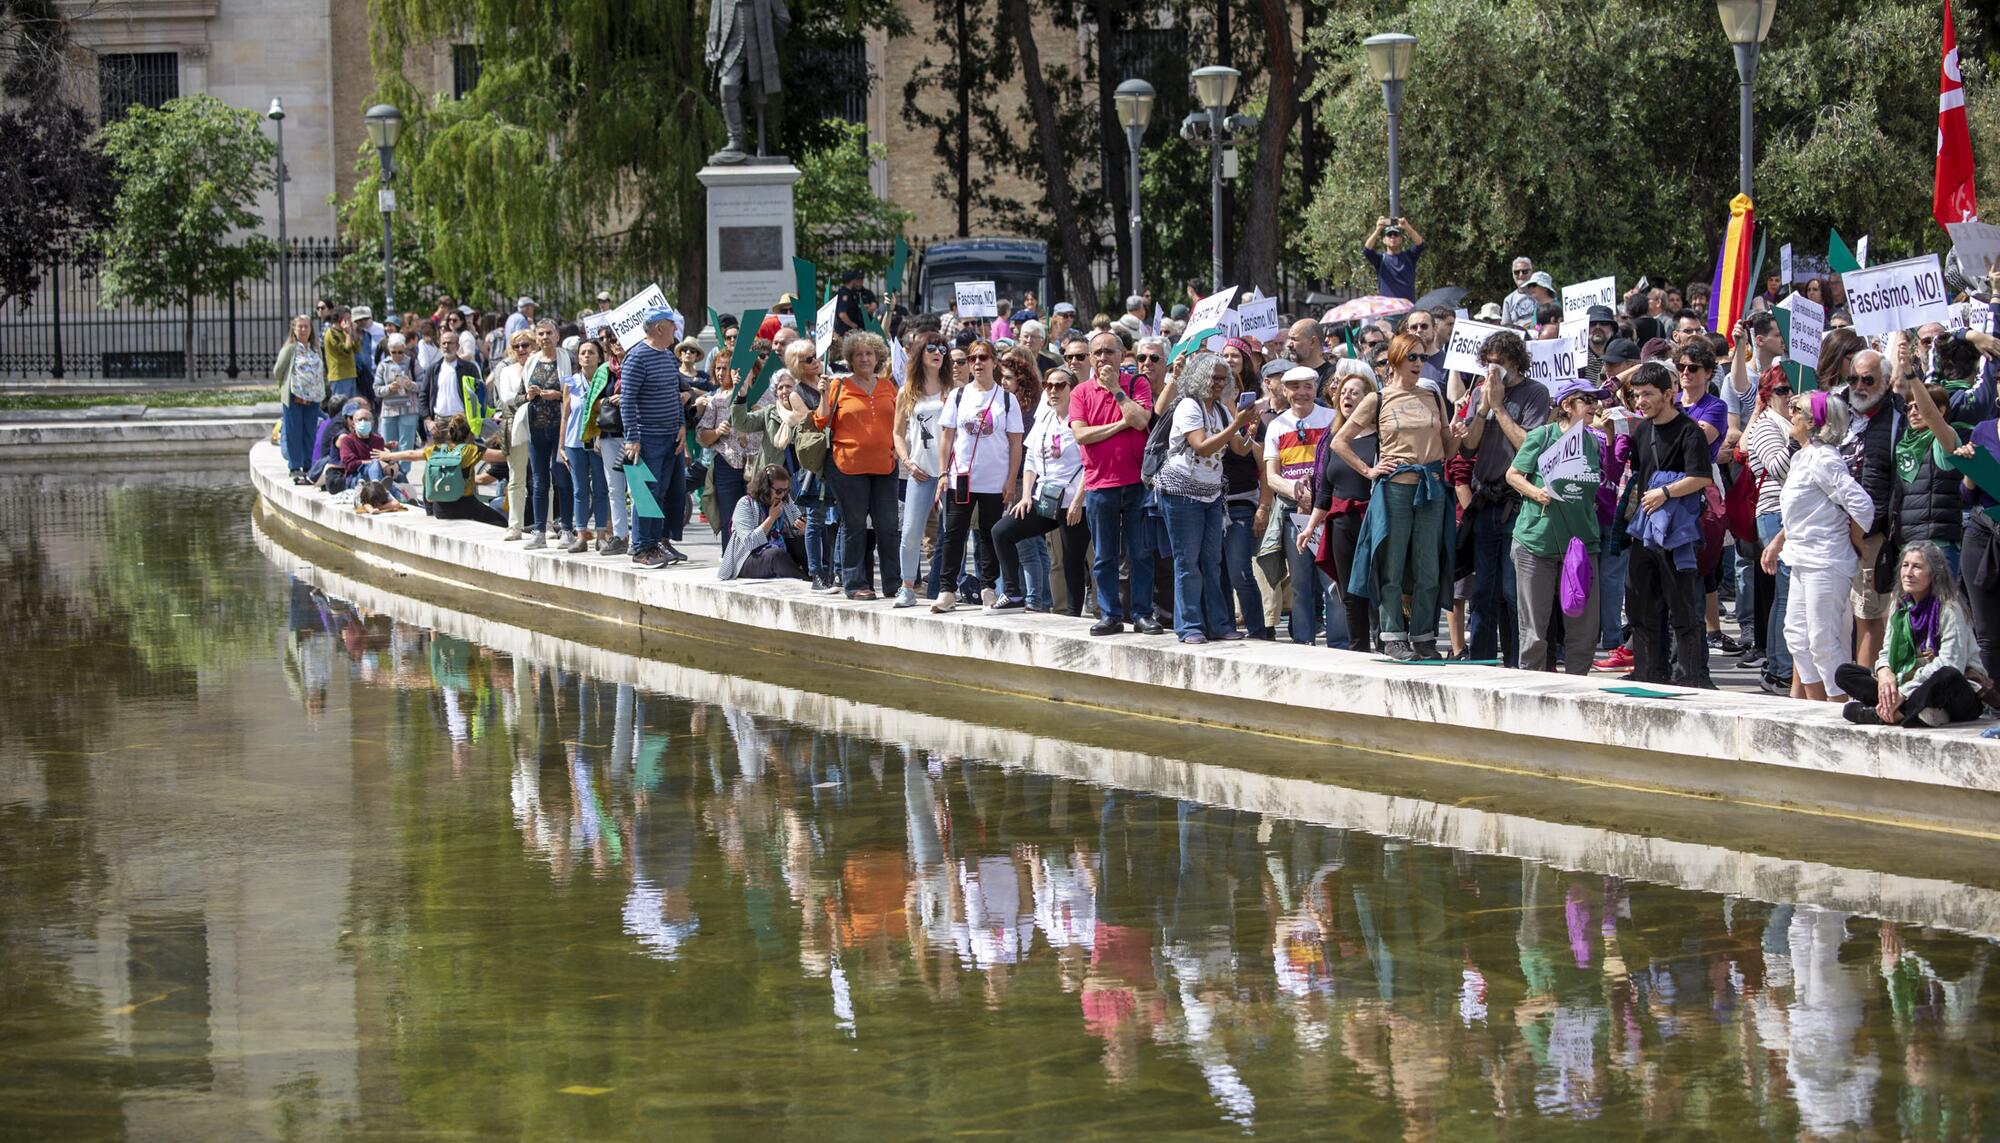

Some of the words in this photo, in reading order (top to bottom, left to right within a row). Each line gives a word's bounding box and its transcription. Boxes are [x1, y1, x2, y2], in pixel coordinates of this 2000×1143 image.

[1564, 293, 1600, 312] Fascismo,
[1601, 286, 1614, 304] NO!
[1847, 283, 1915, 314] Fascismo,
[1914, 271, 1942, 302] NO!
[1451, 331, 1481, 356] Fascis
[1525, 360, 1552, 382] smo,
[1553, 351, 1575, 376] NO!
[1562, 433, 1580, 460] NO!
